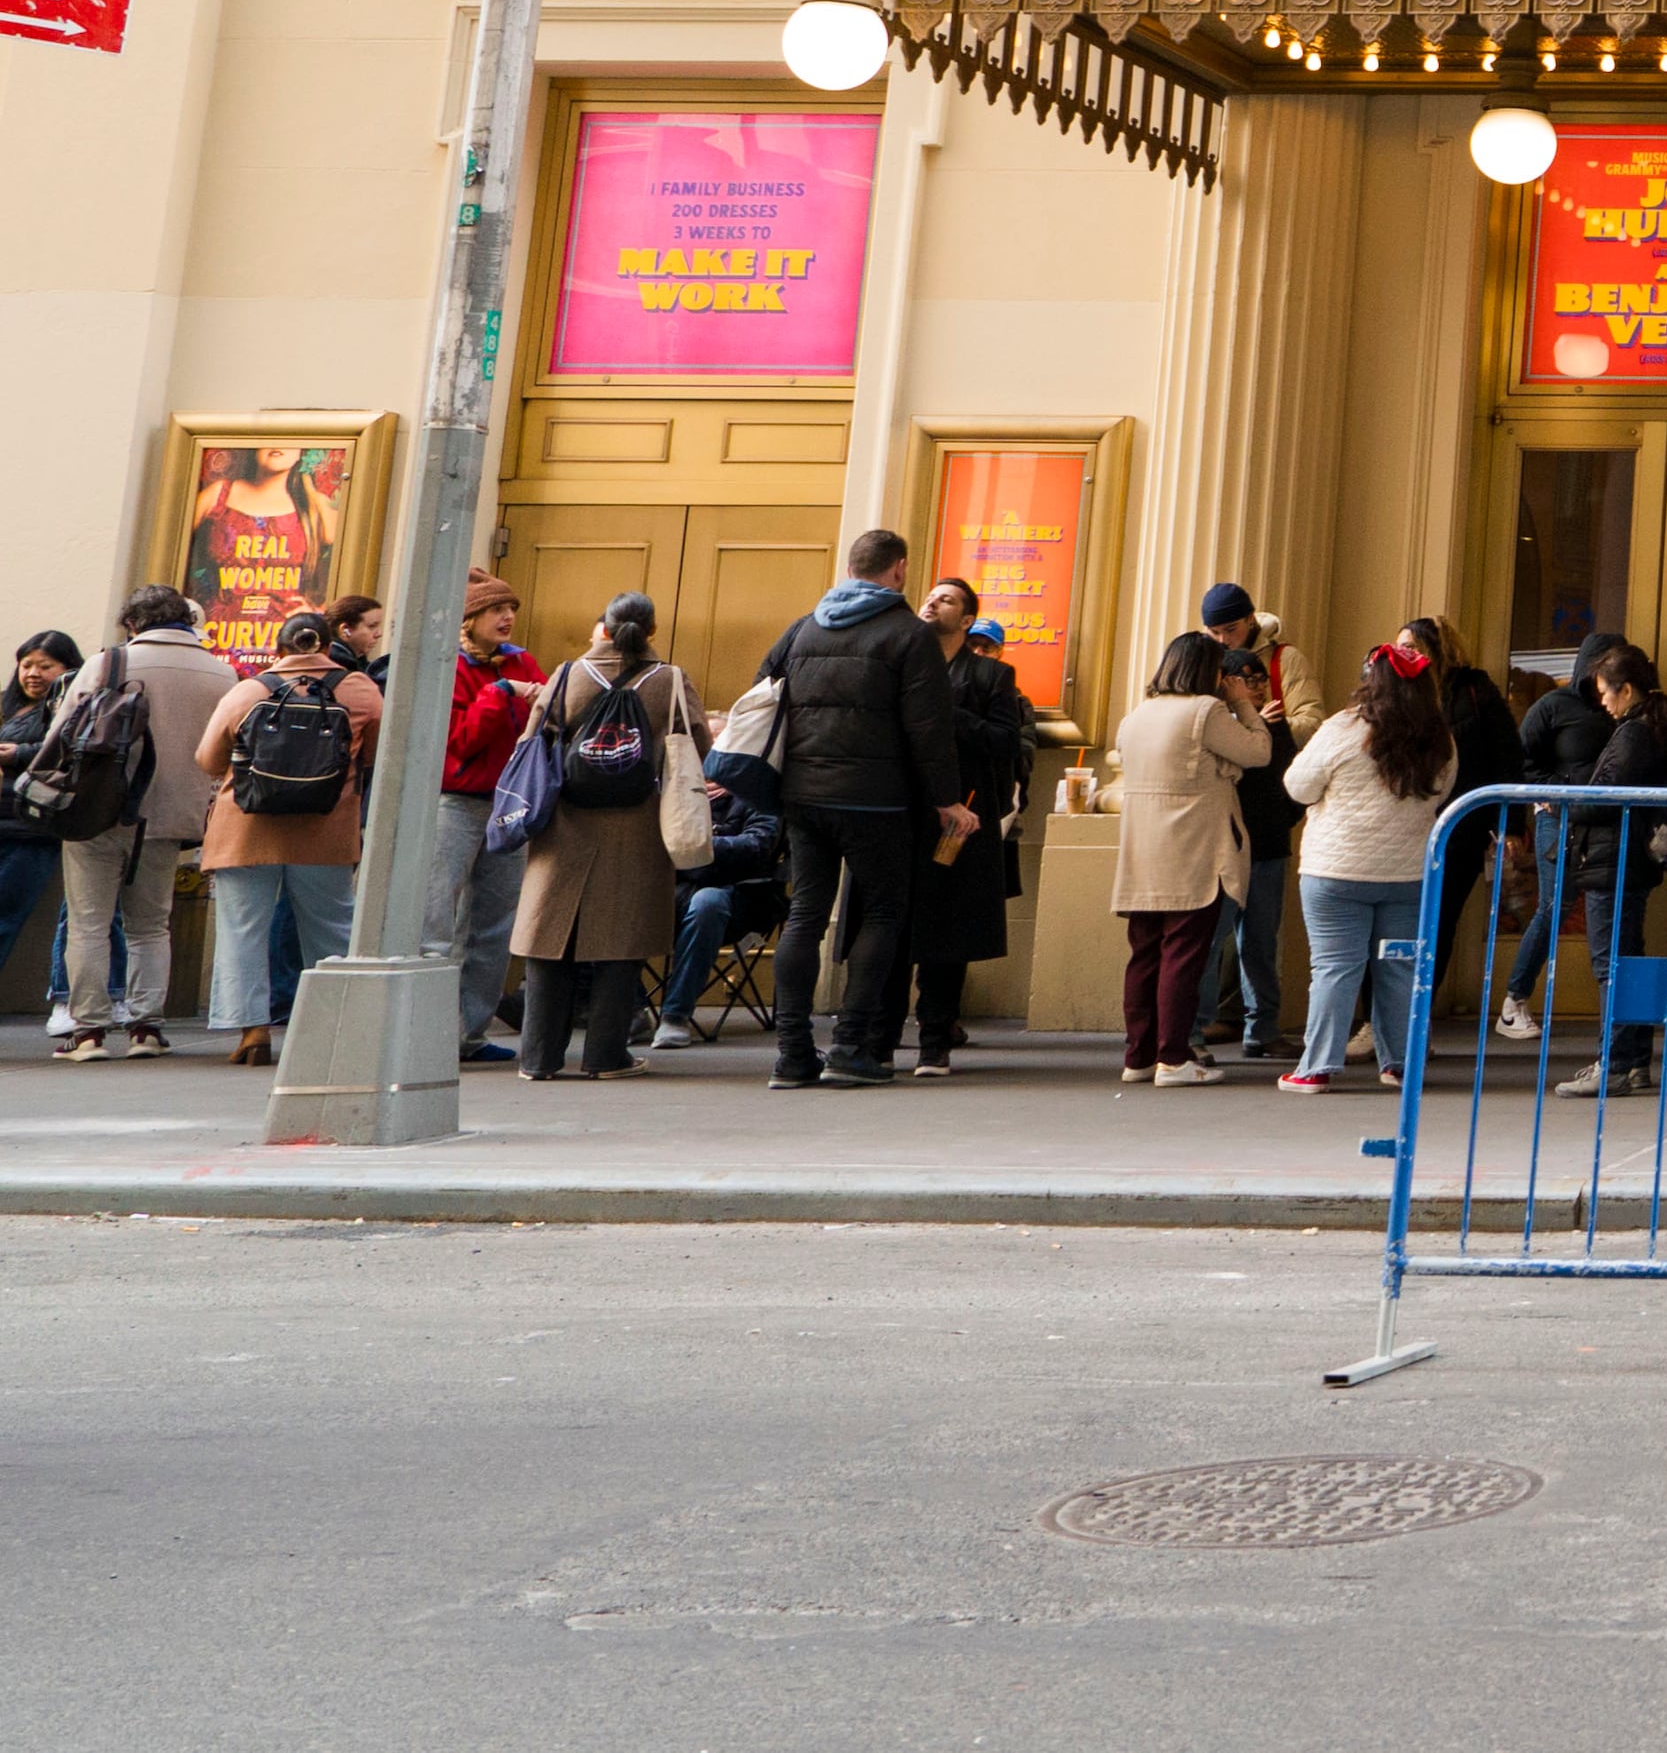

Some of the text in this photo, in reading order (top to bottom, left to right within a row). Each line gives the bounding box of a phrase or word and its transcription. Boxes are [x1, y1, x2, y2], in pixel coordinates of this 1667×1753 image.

[661, 182, 721, 196] FAMILY
[727, 182, 806, 197] BUSINESS
[462, 206, 474, 223] 8
[672, 204, 778, 219] 200 DRESSES
[674, 226, 771, 240] 3 WEEKS TO
[617, 248, 817, 280] MAKE IT
[638, 282, 788, 314] WORK
[959, 525, 1064, 542] WINNER!
[235, 535, 290, 559] REAL
[219, 567, 301, 590] WOMEN
[982, 564, 1026, 580] BIG
